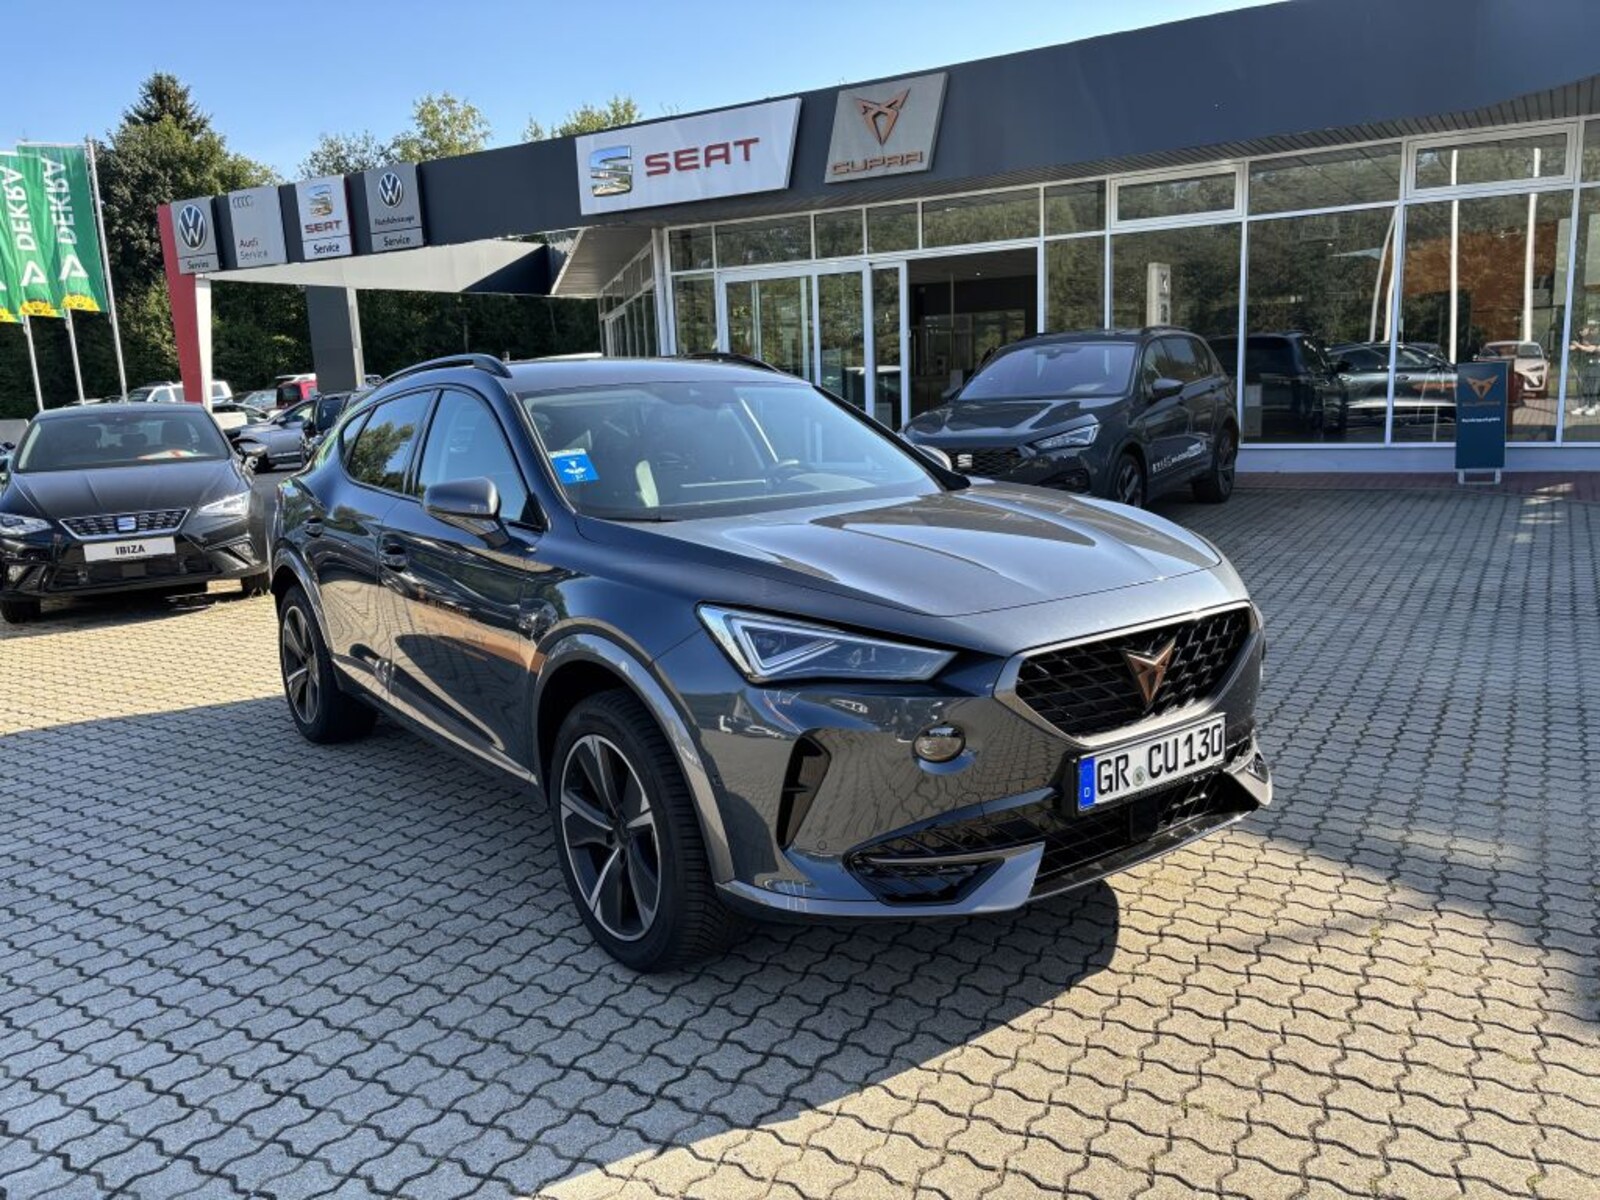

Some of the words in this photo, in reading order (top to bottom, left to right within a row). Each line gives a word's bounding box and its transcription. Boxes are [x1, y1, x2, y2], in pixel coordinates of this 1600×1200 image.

[645, 137, 759, 176] SEAT
[831, 150, 923, 176] CUPRA
[304, 219, 342, 234] SEAT
[239, 237, 259, 248] Audi
[313, 240, 340, 254] Service
[383, 234, 411, 247] Service
[240, 249, 268, 261] Service
[187, 259, 210, 270] Service
[115, 545, 145, 555] IBIZA
[1097, 753, 1130, 795] GR
